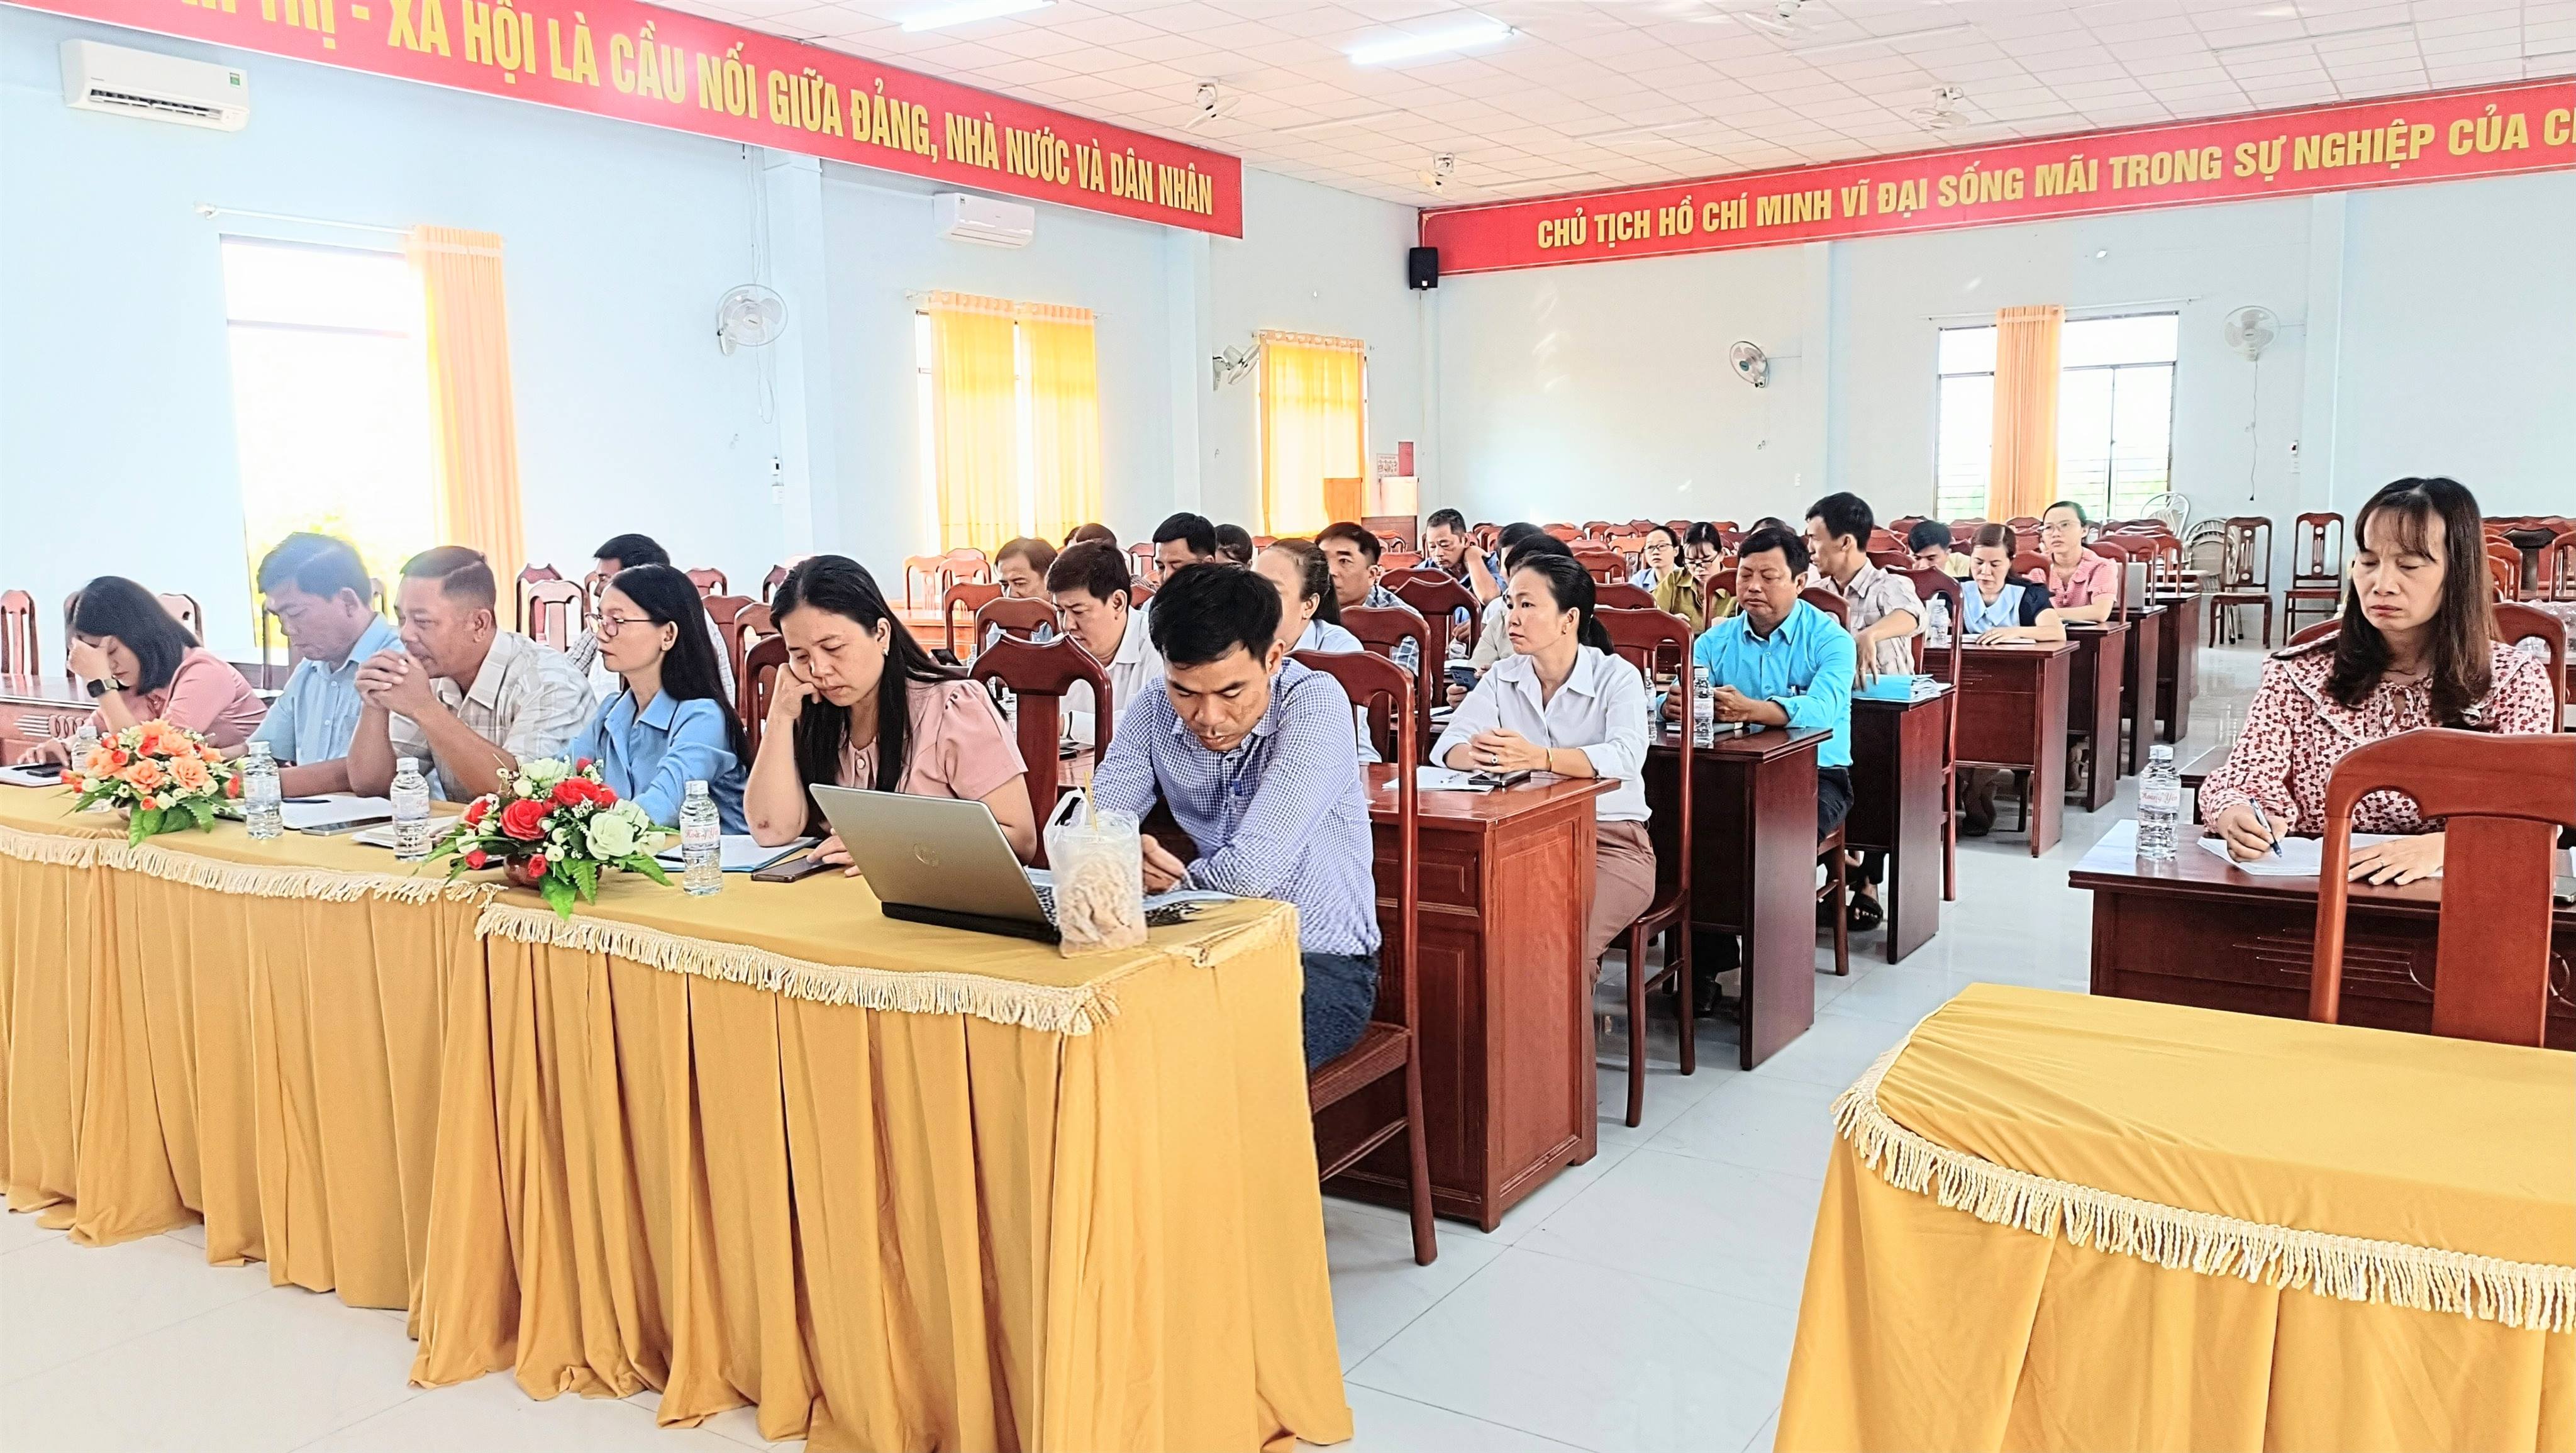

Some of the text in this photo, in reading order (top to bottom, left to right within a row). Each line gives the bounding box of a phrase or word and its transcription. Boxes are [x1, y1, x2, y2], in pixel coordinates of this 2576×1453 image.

[461, 0, 536, 84] HỘI
[548, 11, 600, 87] LÀ
[611, 19, 686, 104] CẦU
[699, 42, 758, 120] NỐI
[769, 68, 843, 138] GIỮA
[851, 78, 938, 163] ĐẢNG,
[946, 112, 1000, 170] NHÀ
[1006, 128, 1070, 186] NƯỚC
[1076, 138, 1106, 193] VÀ
[1111, 148, 1153, 203] DÂN
[1159, 161, 1213, 215] NHÂN
[1538, 103, 2576, 249] CHỦ TỊCH HỒ CHÍ MINH VĨ ĐẠI SỐNG MÃI TRONG SỰ NGHIỆP CỦA C
